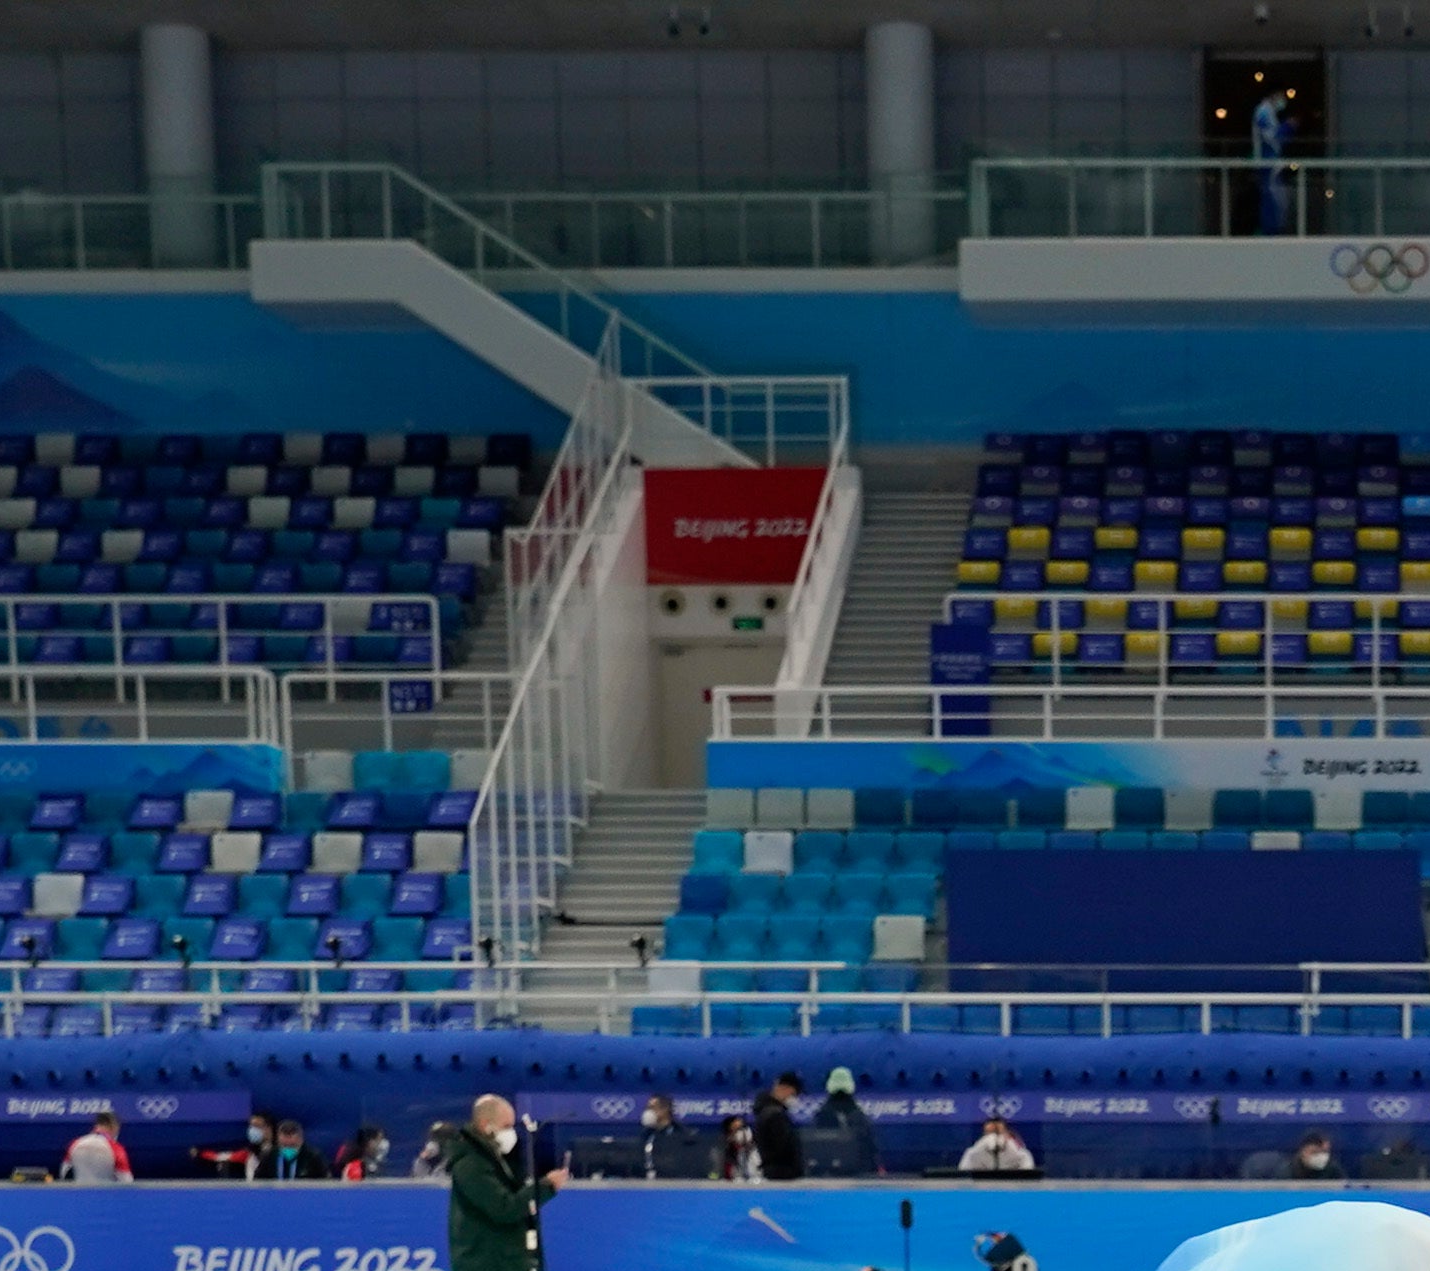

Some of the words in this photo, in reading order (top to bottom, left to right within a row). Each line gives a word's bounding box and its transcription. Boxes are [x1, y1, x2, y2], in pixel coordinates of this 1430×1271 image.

[674, 517, 749, 543] BEIJING
[754, 517, 808, 539] 2022
[1302, 758, 1369, 779] BEIJING
[1372, 758, 1423, 776] 2022
[1044, 1099, 1102, 1118] BEIJING
[1236, 1100, 1294, 1119] BEIJING
